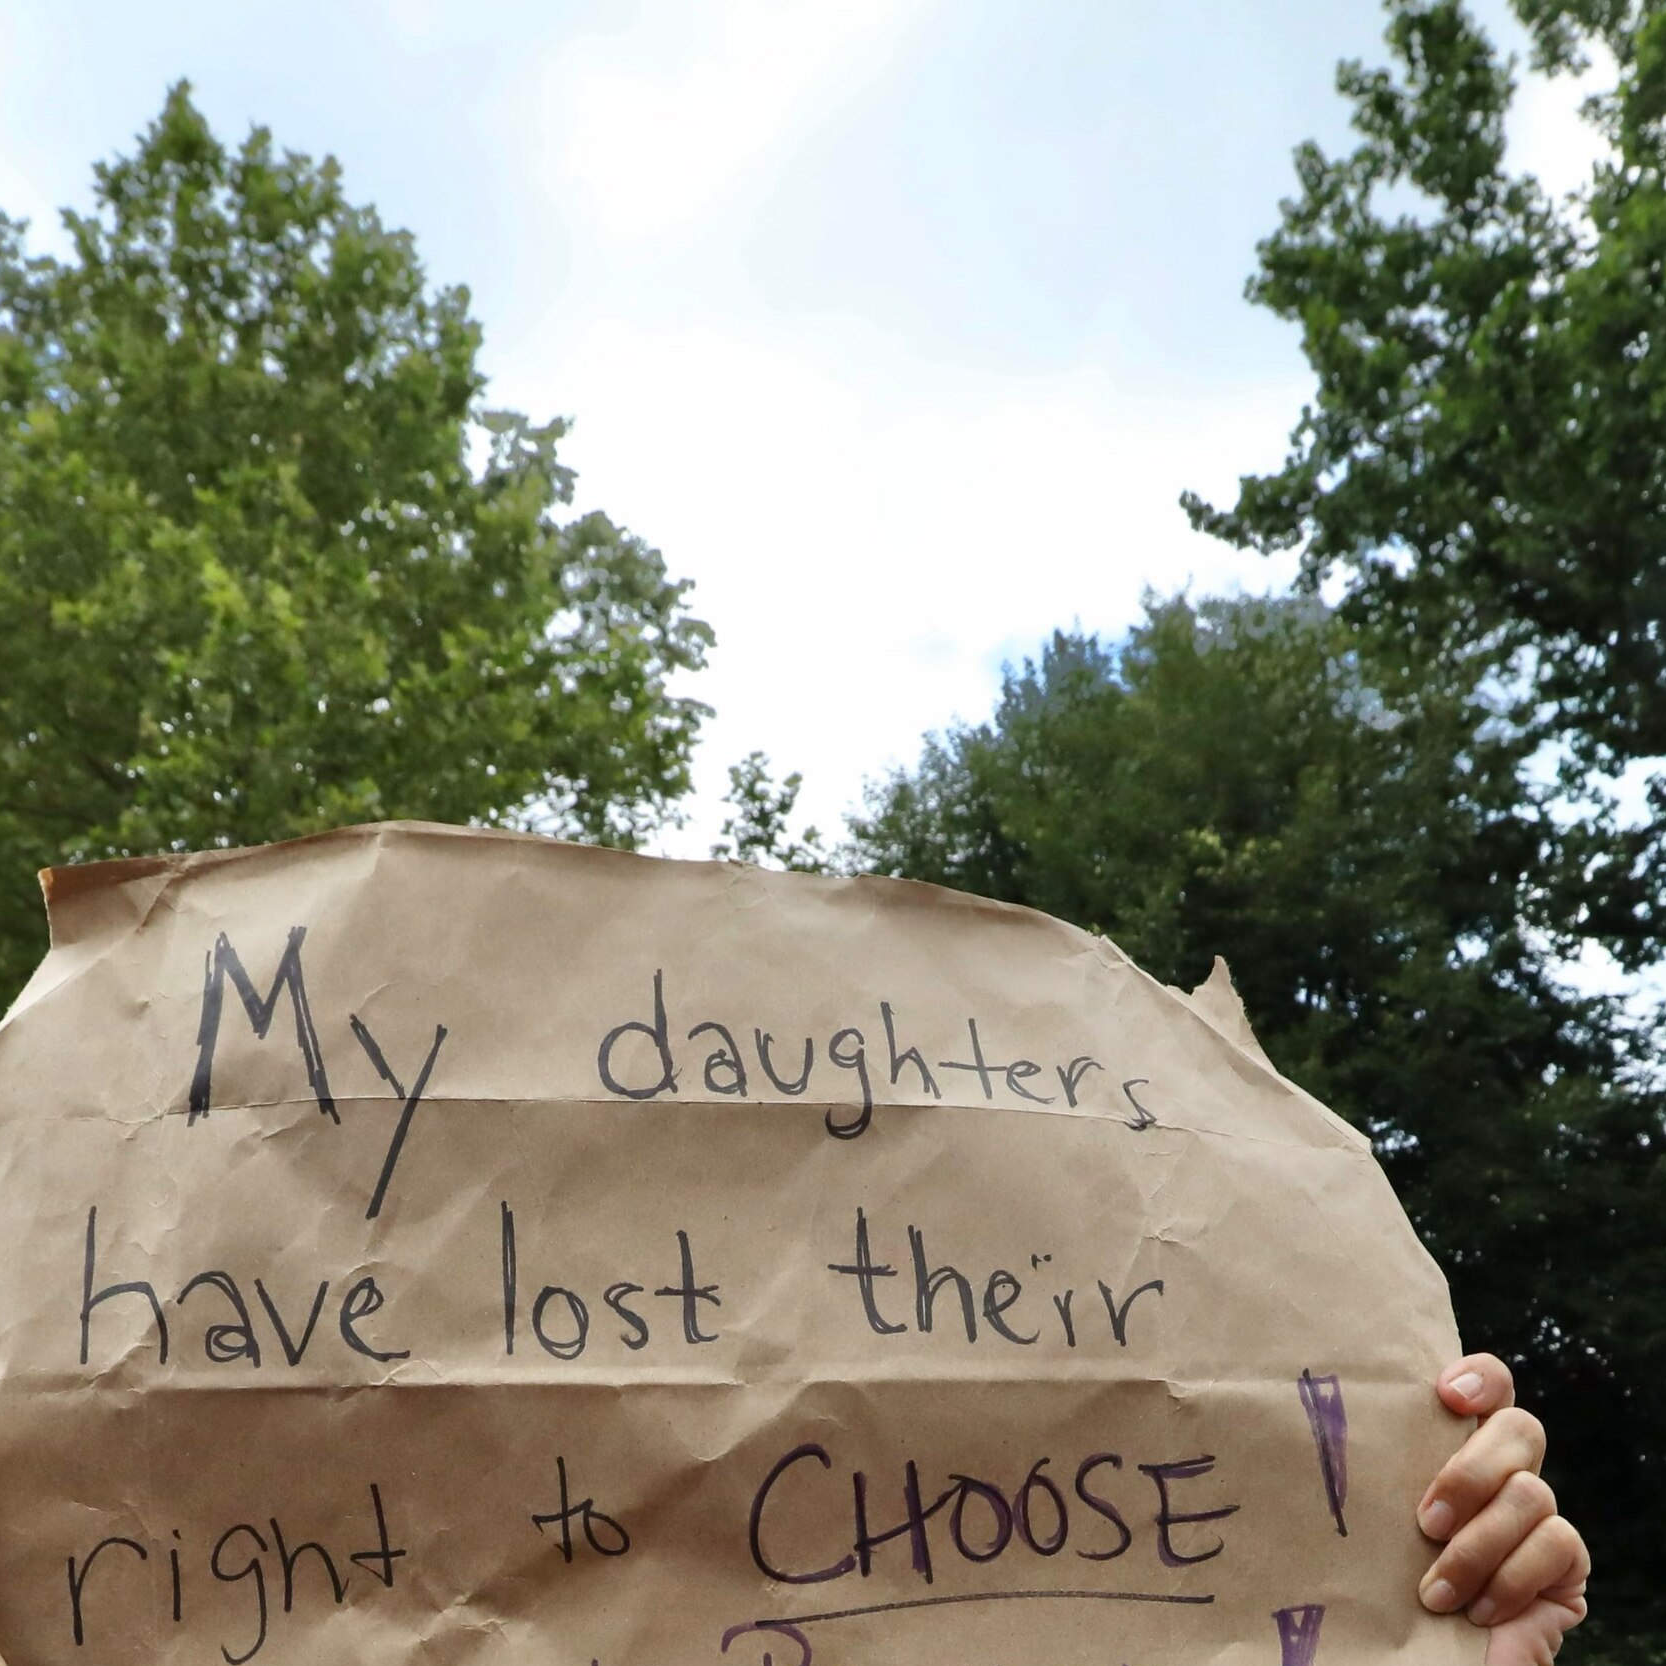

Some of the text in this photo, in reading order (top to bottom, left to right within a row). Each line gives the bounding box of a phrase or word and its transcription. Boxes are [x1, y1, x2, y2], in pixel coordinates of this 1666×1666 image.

[188, 926, 1158, 1220] My daughters
[80, 1200, 1164, 1368] have lost their
[68, 1483, 407, 1666] right
[532, 1456, 631, 1564] to
[749, 1443, 1240, 1585] CHOOSE
